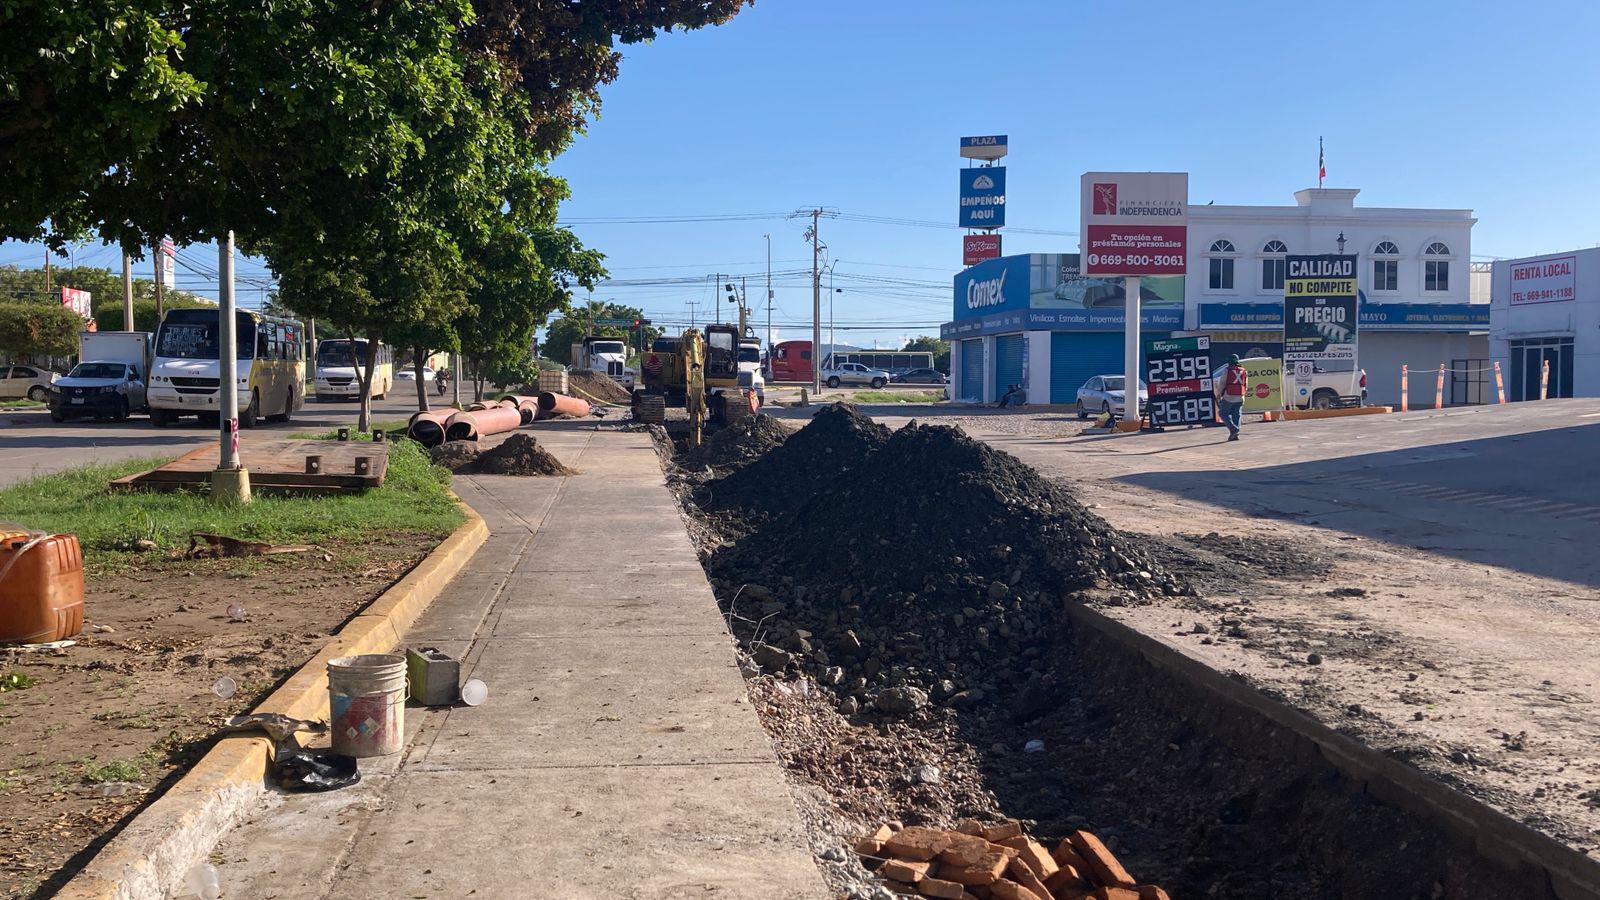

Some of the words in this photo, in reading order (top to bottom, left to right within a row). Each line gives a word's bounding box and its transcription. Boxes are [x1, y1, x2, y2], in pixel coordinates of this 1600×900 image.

[971, 137, 997, 145] PLAZA
[961, 194, 1005, 206] EMPEÑOS
[970, 207, 994, 219] AQUÍ
[1120, 207, 1182, 216] INDEPENDENCIA
[1092, 240, 1135, 248] préstamos
[1124, 234, 1151, 243] opción
[1100, 255, 1184, 266] 669-500-3061
[1289, 260, 1352, 276] CALIDAD
[1514, 266, 1541, 280] RENTA
[1543, 262, 1571, 277] LOCAL
[967, 268, 1007, 310] Comex
[1289, 282, 1303, 294] NO
[1306, 281, 1352, 294] COMPITE
[1512, 292, 1525, 302] TEL:
[1527, 288, 1573, 300] 669-941-1188
[1295, 306, 1346, 323] PRECIO
[1360, 313, 1387, 321] MAYO
[1153, 343, 1178, 352] Magna
[1148, 356, 1211, 383] 23.99
[1260, 368, 1279, 377] CON
[1299, 365, 1309, 373] 10
[1156, 386, 1190, 394] Premium
[1151, 397, 1214, 425] 26.89
